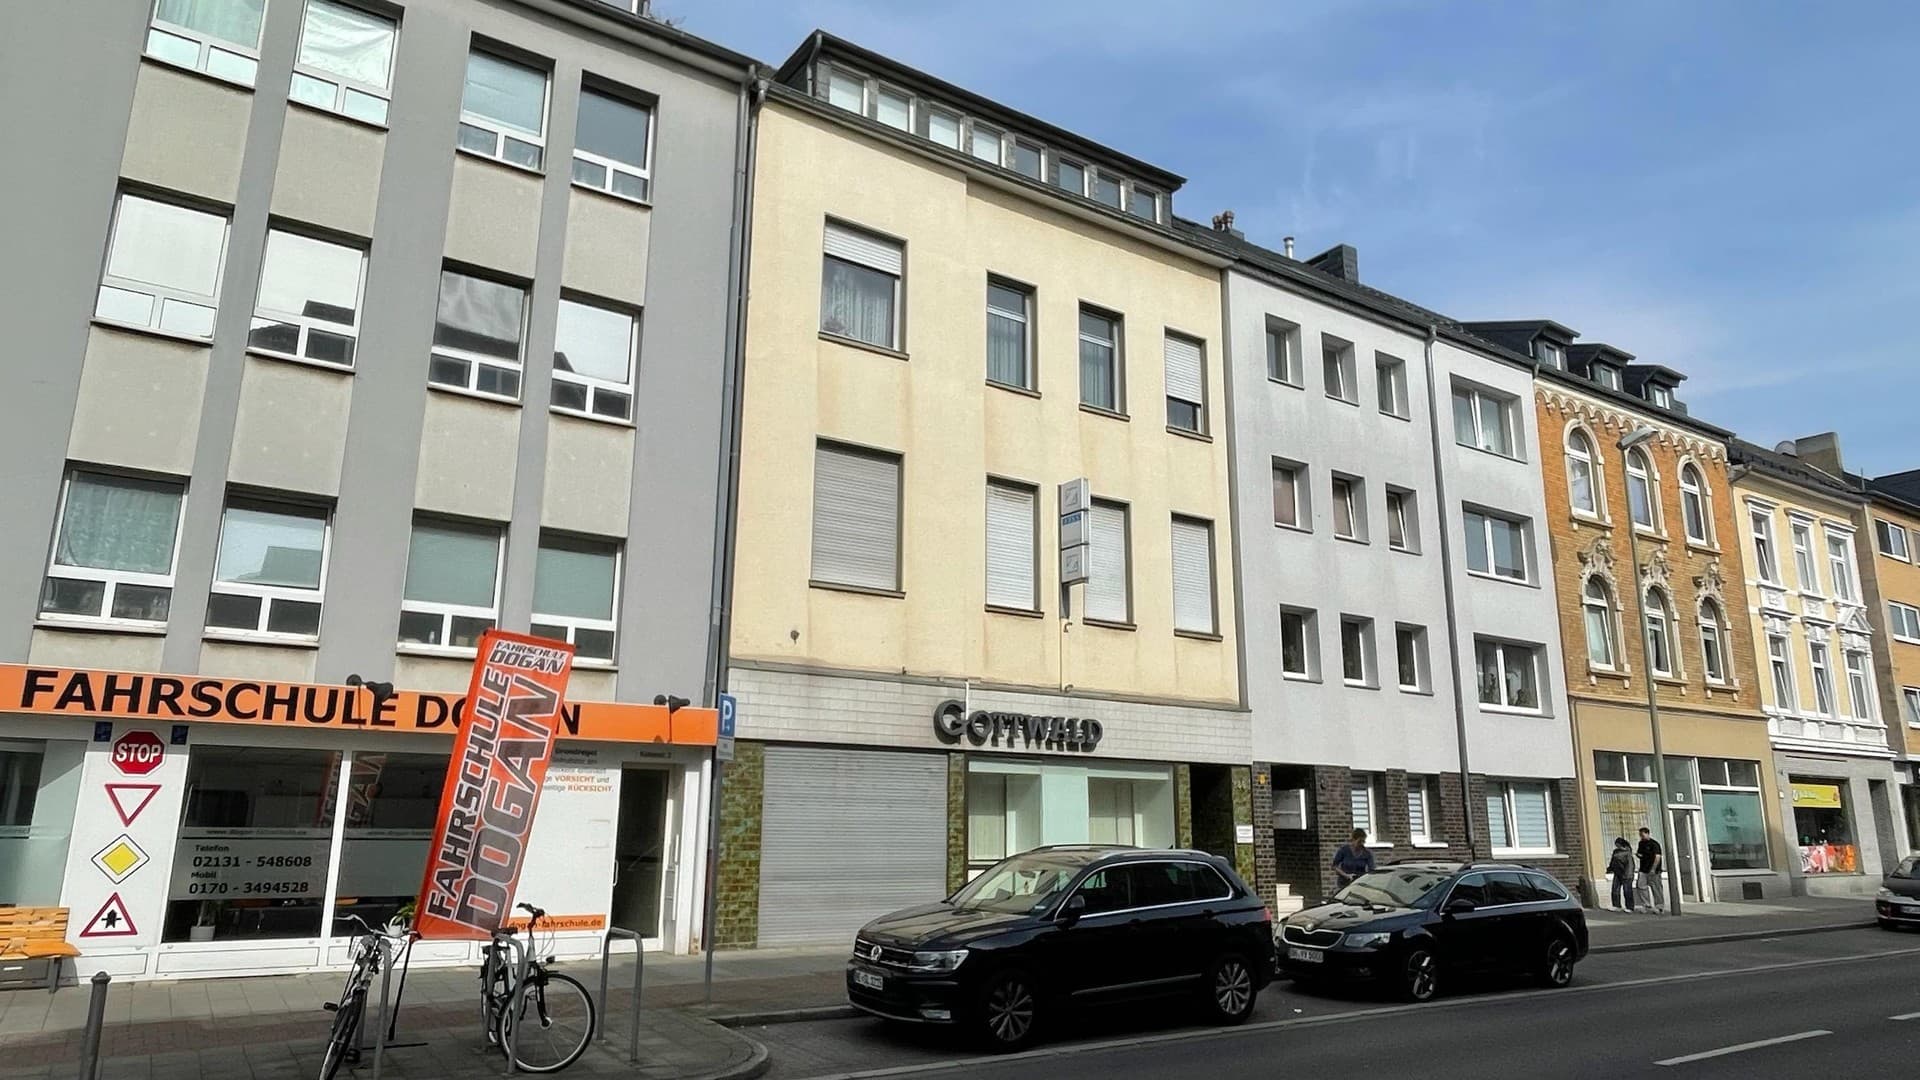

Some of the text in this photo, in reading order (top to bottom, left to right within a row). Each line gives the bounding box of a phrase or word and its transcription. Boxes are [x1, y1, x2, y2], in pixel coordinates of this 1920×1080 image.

[490, 649, 564, 673] DOGAN
[496, 642, 566, 659] FAHRSCHULE
[20, 669, 399, 727] FAHRSCHULE
[722, 700, 733, 732] P
[934, 699, 1103, 752] GOTTWALD
[116, 742, 162, 763] STOP
[554, 775, 595, 784] VORSICHT
[425, 666, 511, 919] FAHRSCHULE
[453, 674, 559, 932] DOGAN
[195, 844, 230, 852] Telefon
[193, 856, 241, 868] 02131
[256, 856, 312, 868] 548608
[190, 871, 217, 879] Mobil
[188, 882, 228, 895] 0170
[243, 881, 309, 893] 3494528
